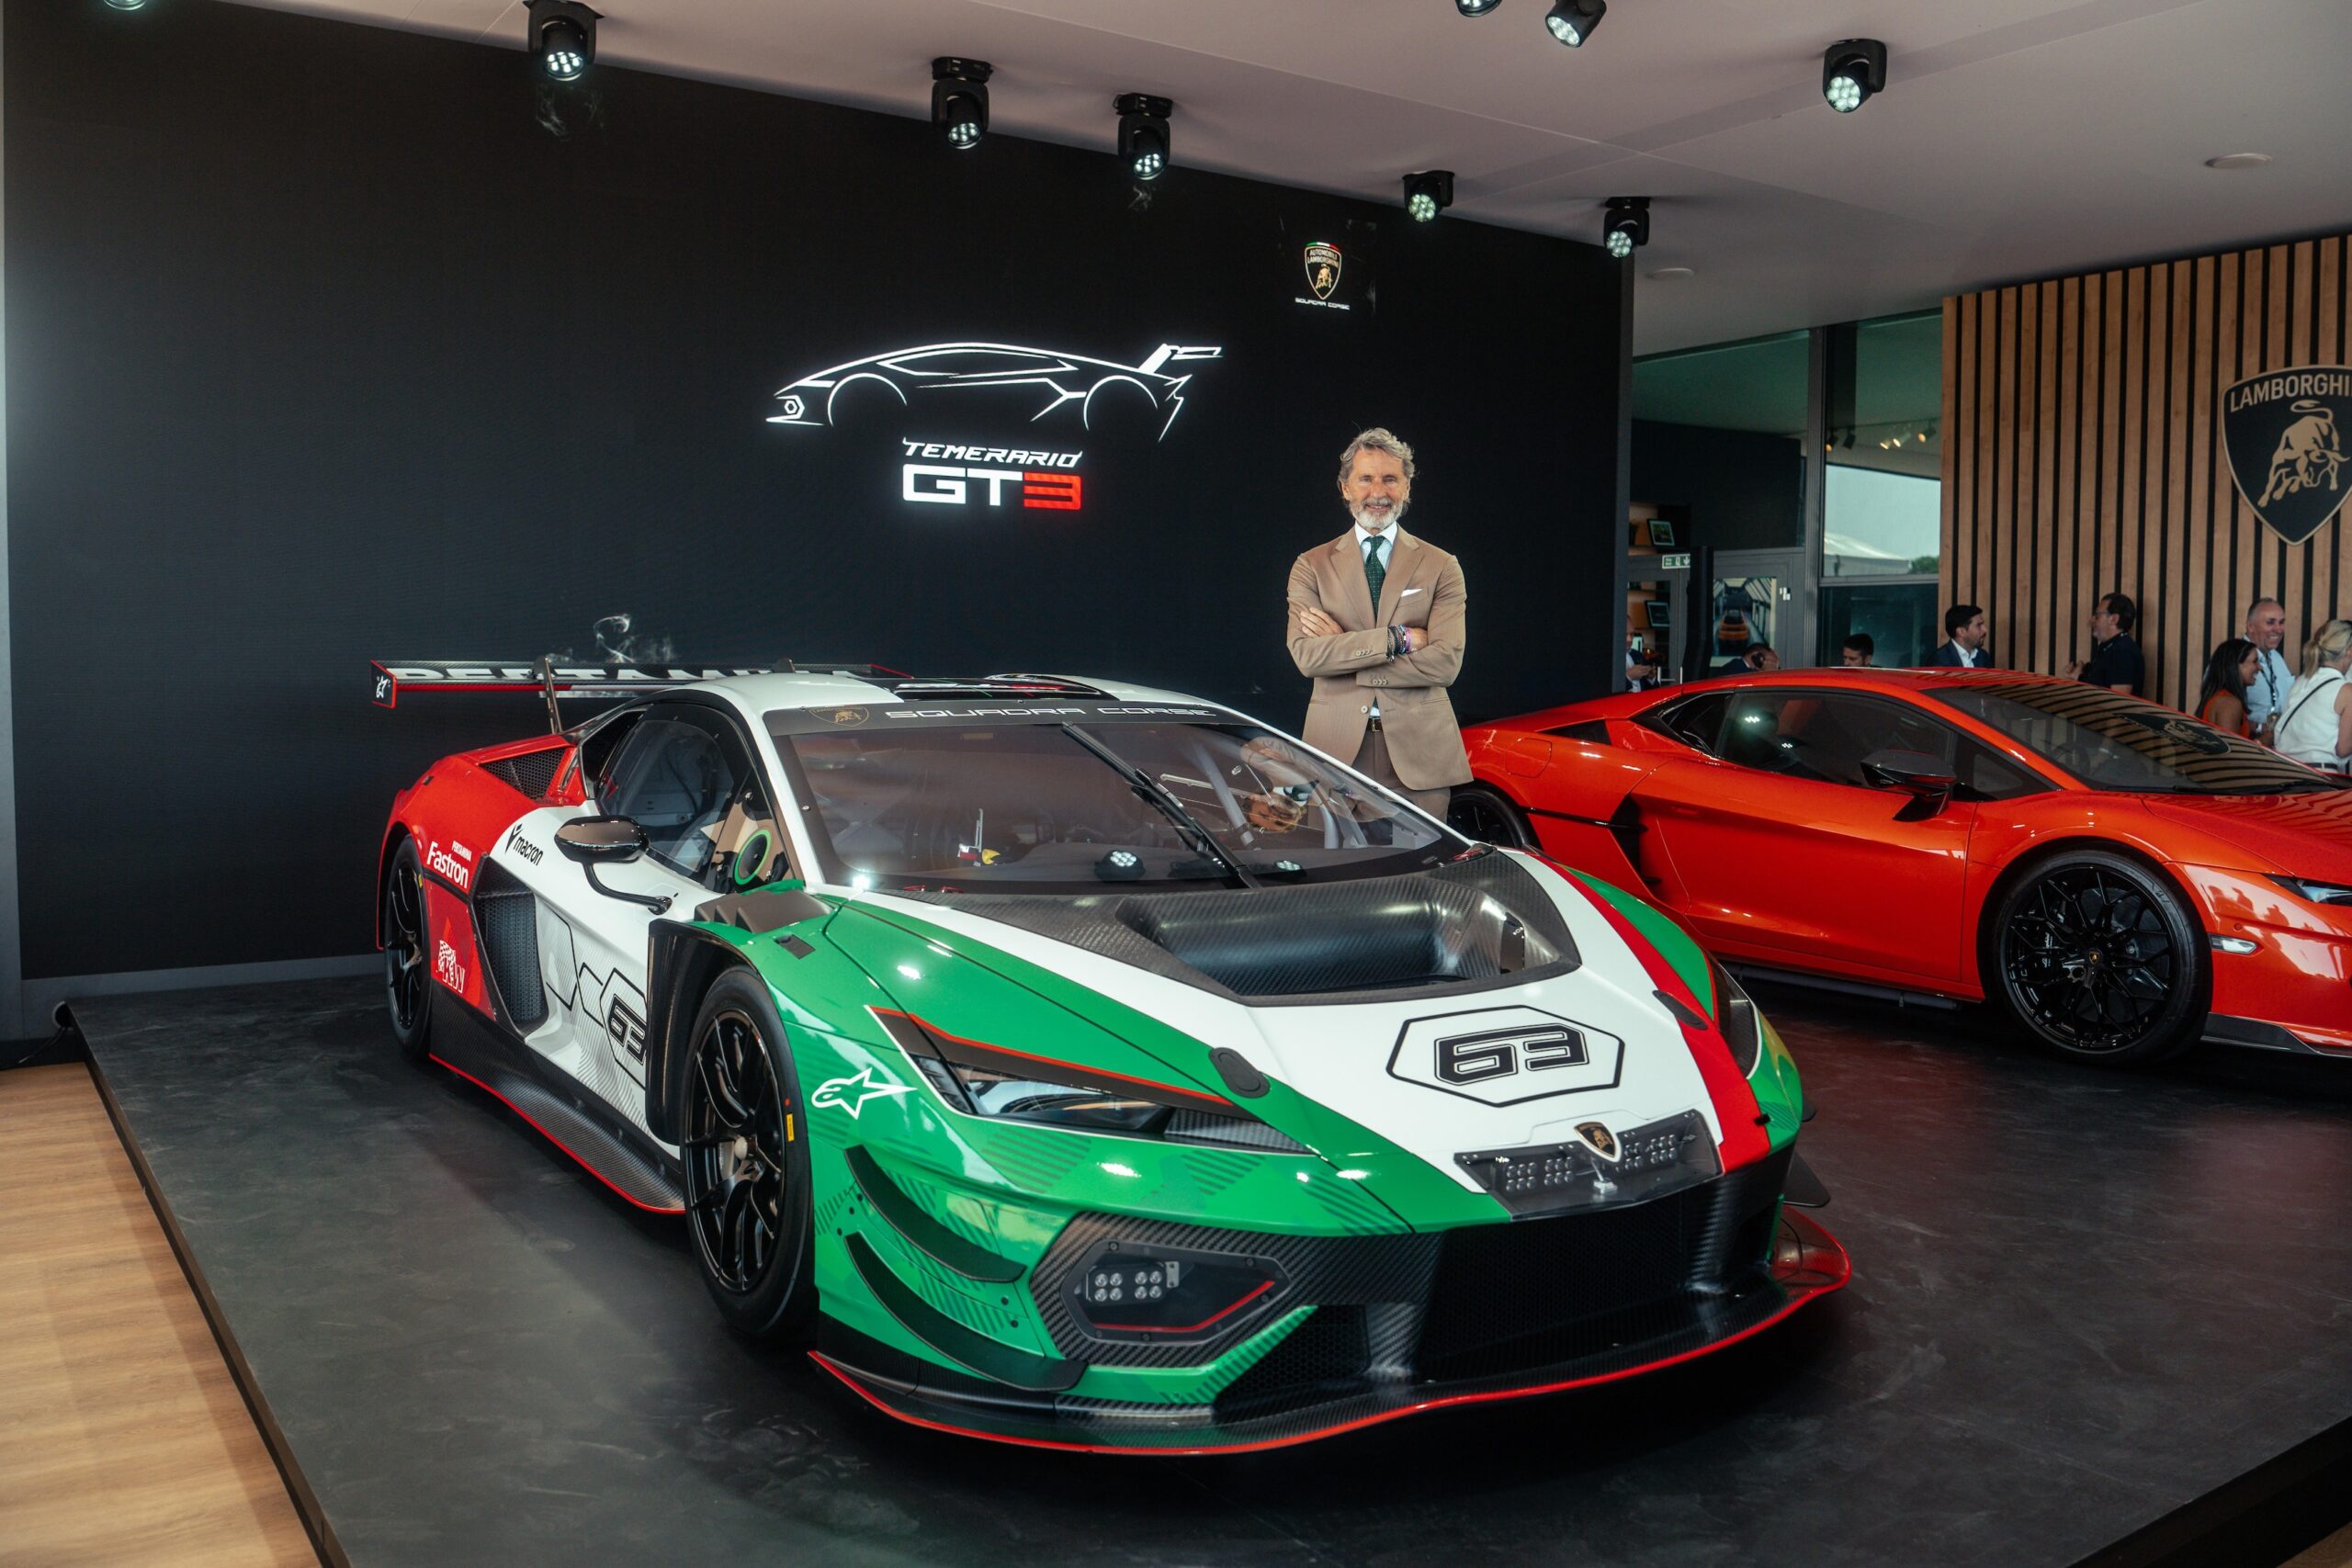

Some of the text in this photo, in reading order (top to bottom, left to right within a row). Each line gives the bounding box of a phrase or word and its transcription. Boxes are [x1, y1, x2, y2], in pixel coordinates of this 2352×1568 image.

[2230, 373, 2352, 413] LAMBORGHI
[902, 436, 1083, 468] TEMERARIO
[902, 464, 1081, 511] GT3
[885, 707, 1217, 719] SQUADRA CORSE
[426, 840, 469, 889] Fastron
[513, 836, 544, 866] macron
[607, 993, 648, 1066] 63
[1433, 1022, 1590, 1087] 63
